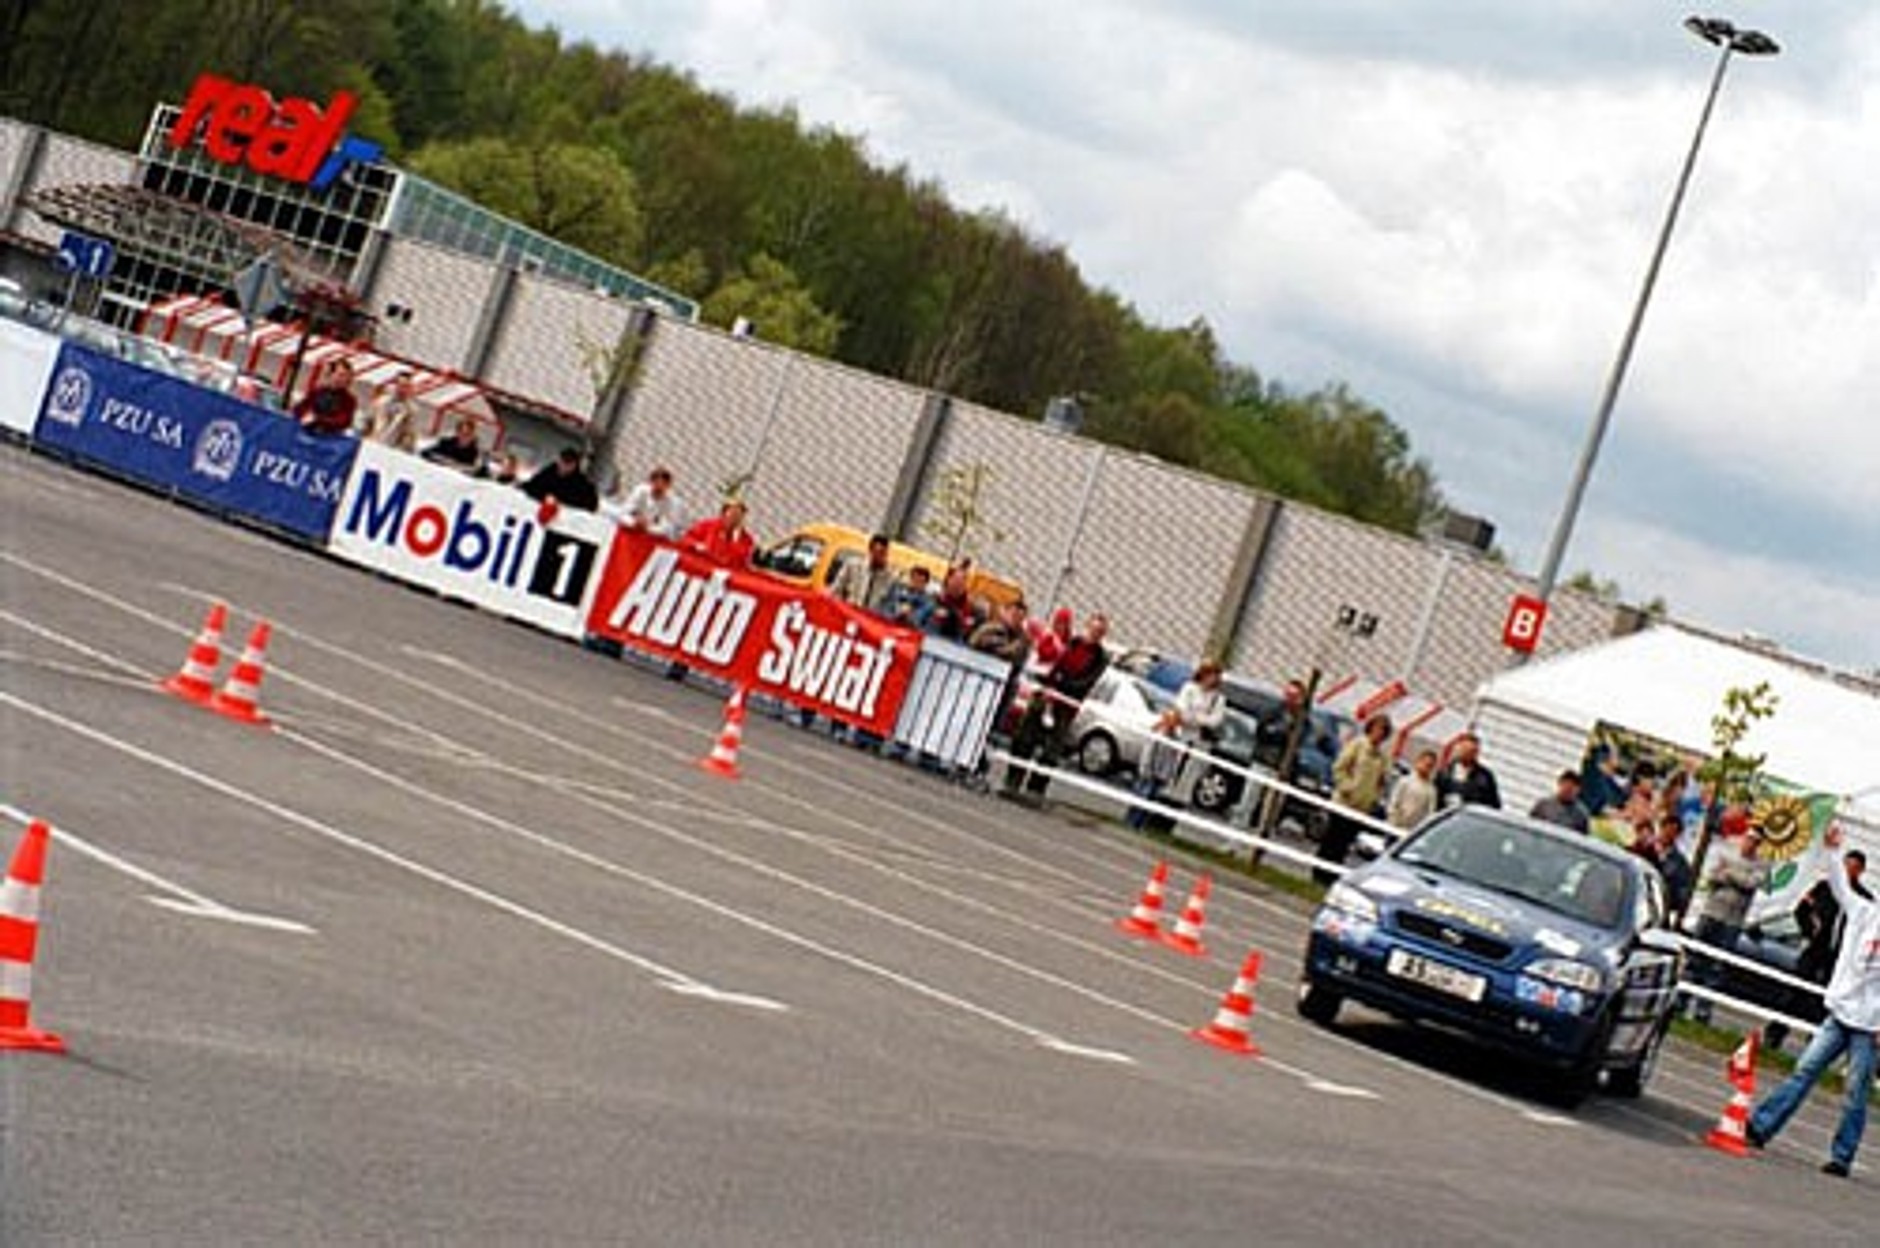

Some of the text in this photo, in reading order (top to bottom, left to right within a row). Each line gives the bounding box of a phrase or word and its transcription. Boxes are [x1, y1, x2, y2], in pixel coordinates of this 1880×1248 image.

[168, 74, 360, 183] real
[100, 398, 183, 449] PZU SA
[253, 450, 342, 500] PZU SA
[345, 469, 582, 598] Mobil 1
[607, 545, 758, 666] Auto
[1510, 608, 1537, 639] B
